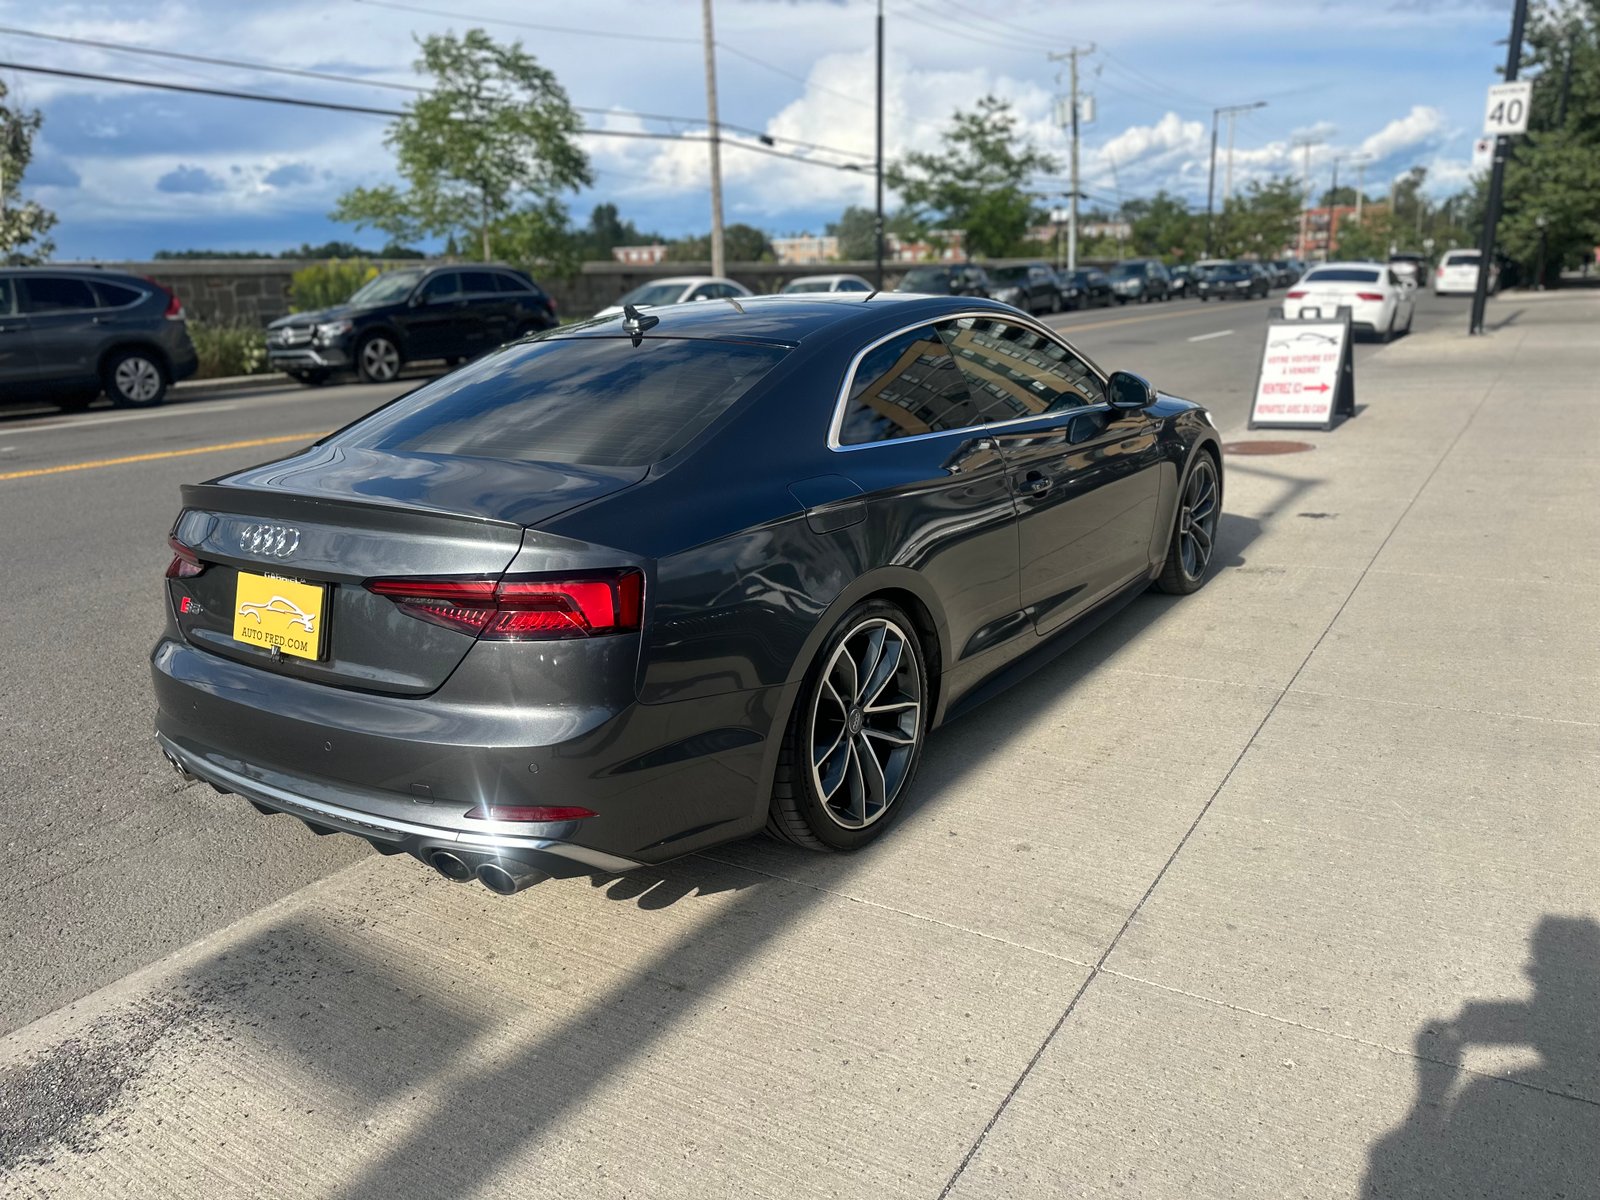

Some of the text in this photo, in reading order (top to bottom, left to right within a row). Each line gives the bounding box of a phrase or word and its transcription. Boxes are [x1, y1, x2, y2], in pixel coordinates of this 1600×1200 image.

[1489, 98, 1523, 126] 40
[1268, 356, 1289, 364] VOTRE
[1292, 355, 1321, 363] VOITURE
[1263, 382, 1292, 394] RENTREZ
[242, 627, 308, 652] AUTO FRED.COM
